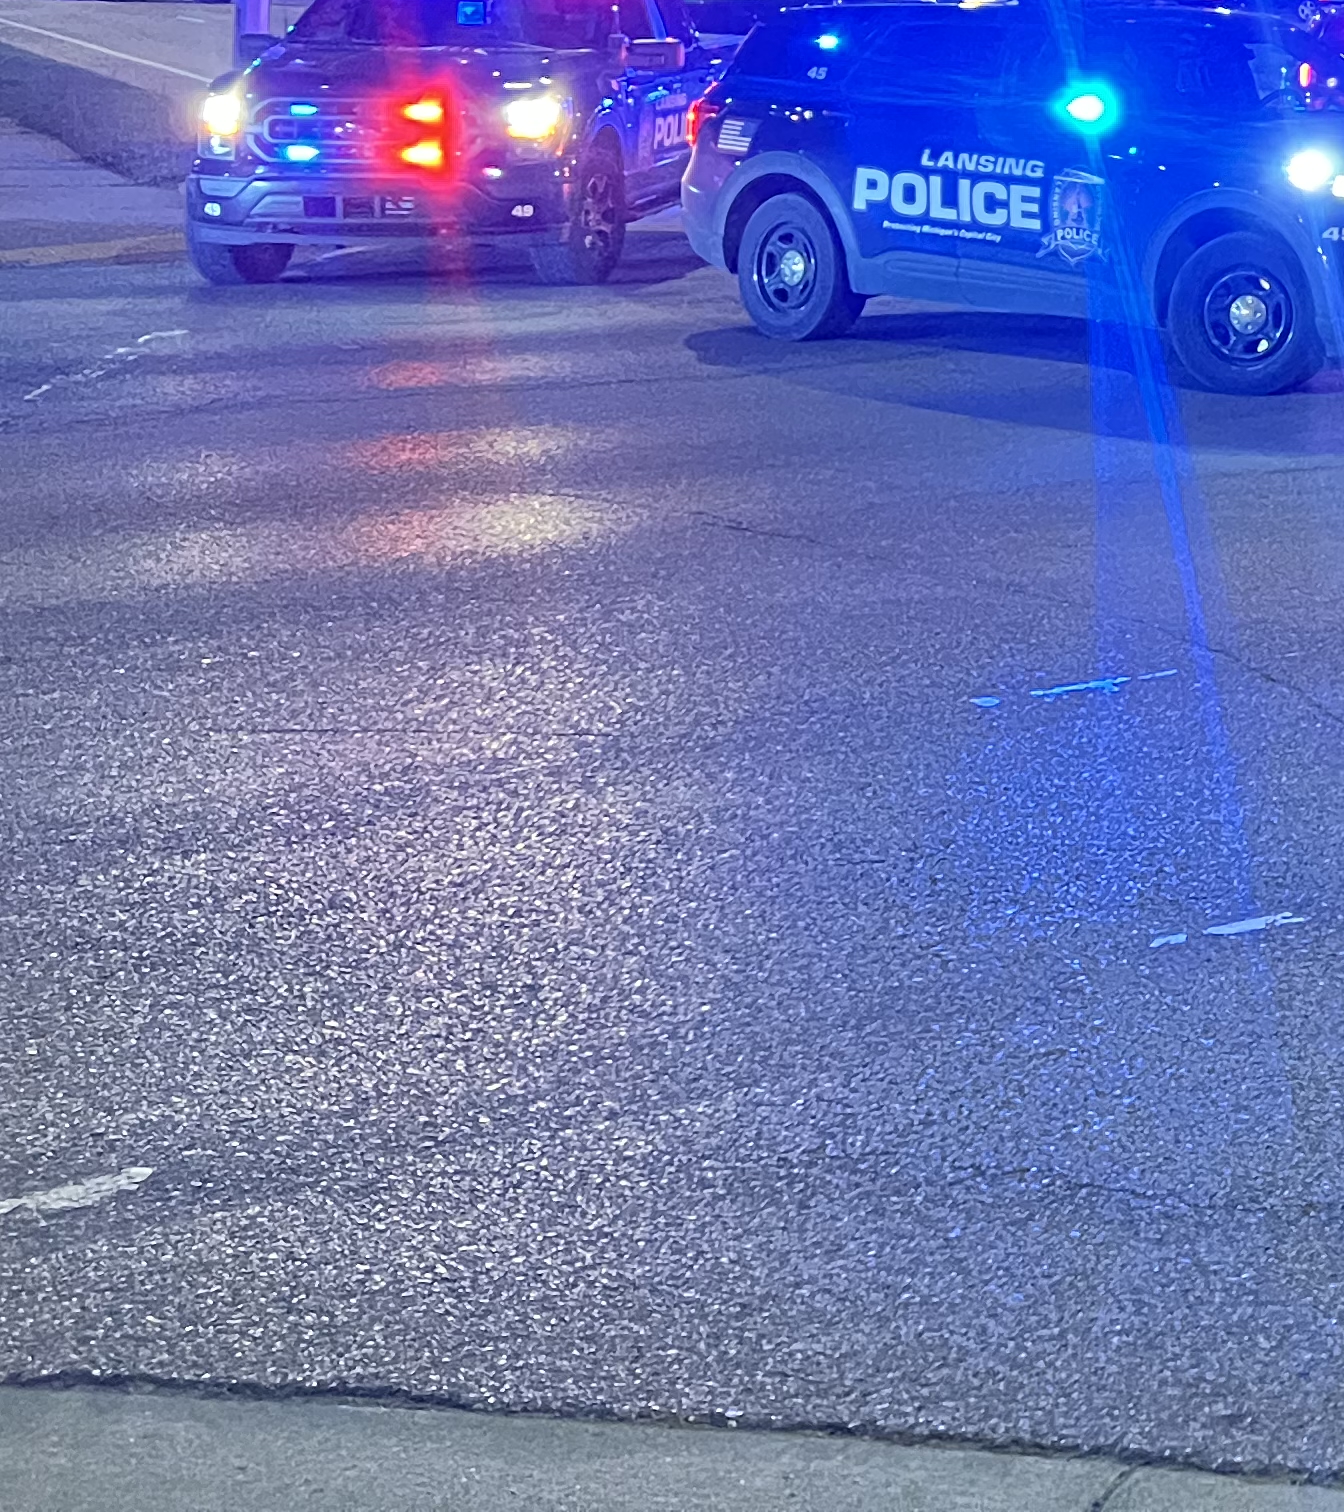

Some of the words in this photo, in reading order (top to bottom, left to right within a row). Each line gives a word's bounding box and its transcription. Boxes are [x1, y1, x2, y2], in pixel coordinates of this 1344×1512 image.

[807, 66, 828, 80] 45
[921, 149, 1044, 177] LANSING
[853, 167, 1042, 230] POLICE
[511, 204, 534, 218] 49
[1056, 227, 1100, 246] POLICE
